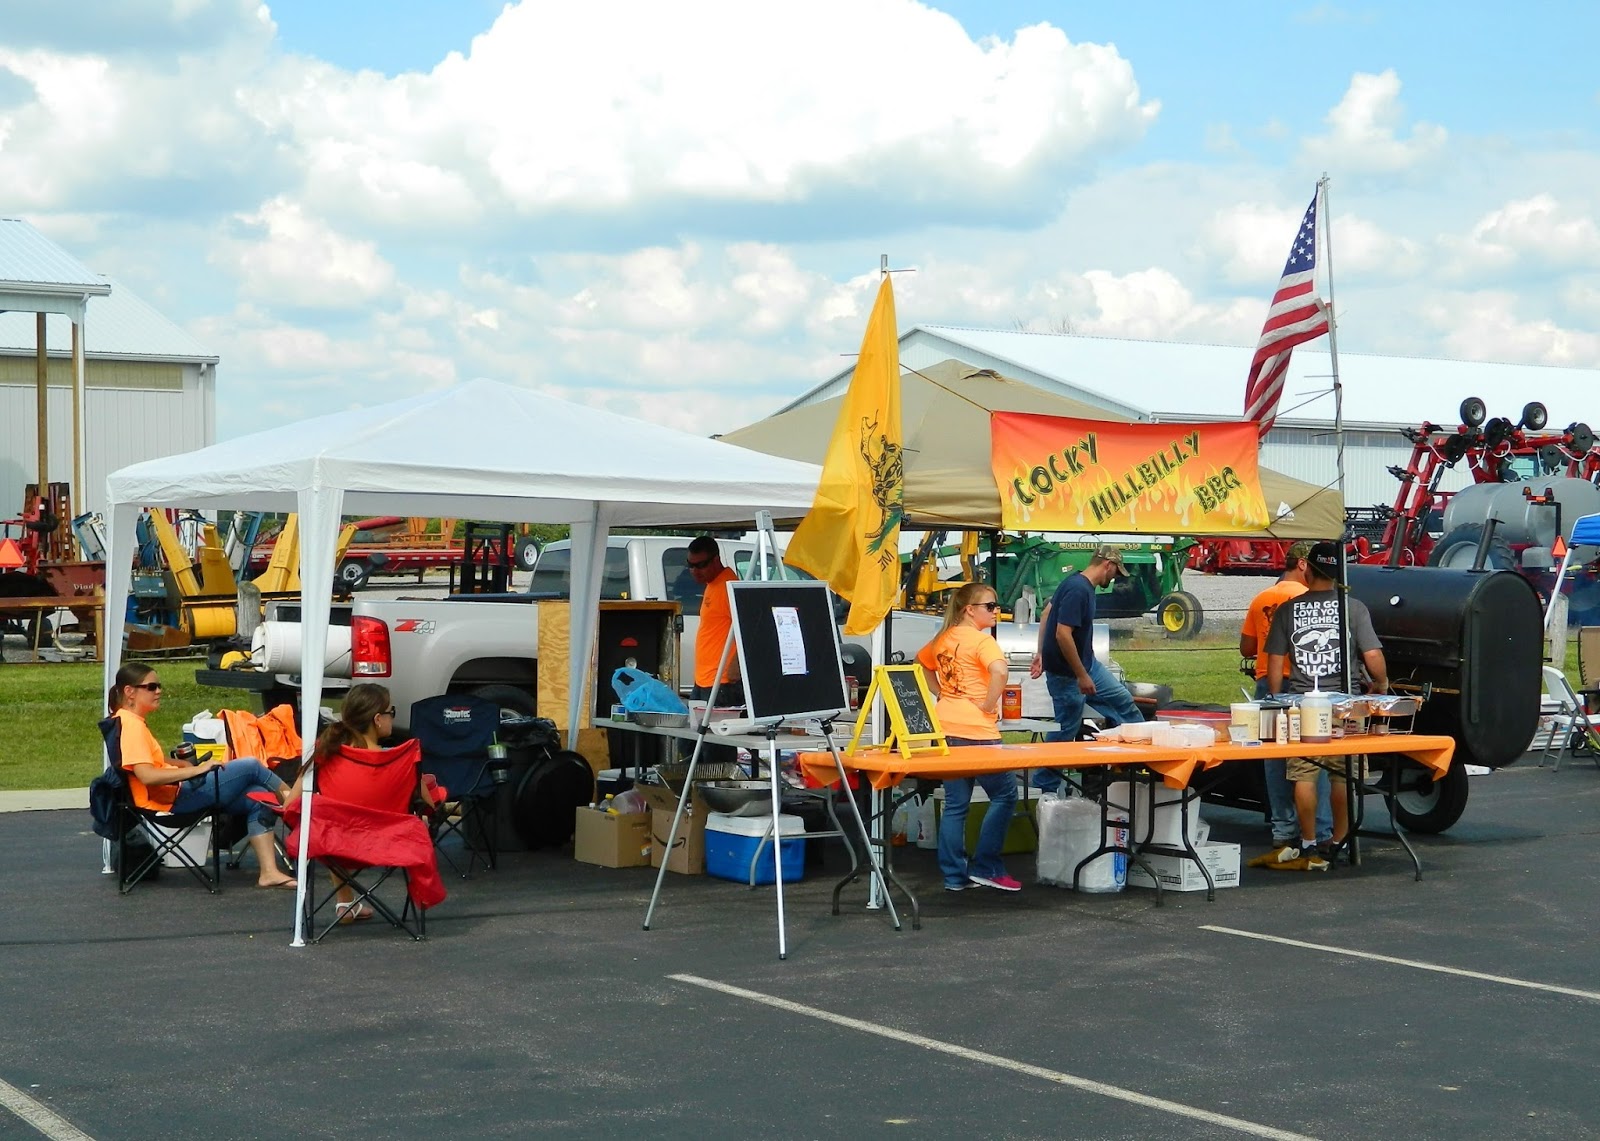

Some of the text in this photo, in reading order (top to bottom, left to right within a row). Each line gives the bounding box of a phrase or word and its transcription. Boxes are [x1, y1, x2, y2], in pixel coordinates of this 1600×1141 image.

[1013, 432, 1098, 505] COCKY
[1088, 430, 1199, 525] HILLBILLY
[1193, 465, 1243, 514] BBQ
[1293, 600, 1340, 610] FEAR GO
[1293, 608, 1340, 618] LOVE YOU
[1293, 615, 1340, 631] NEIGHBO
